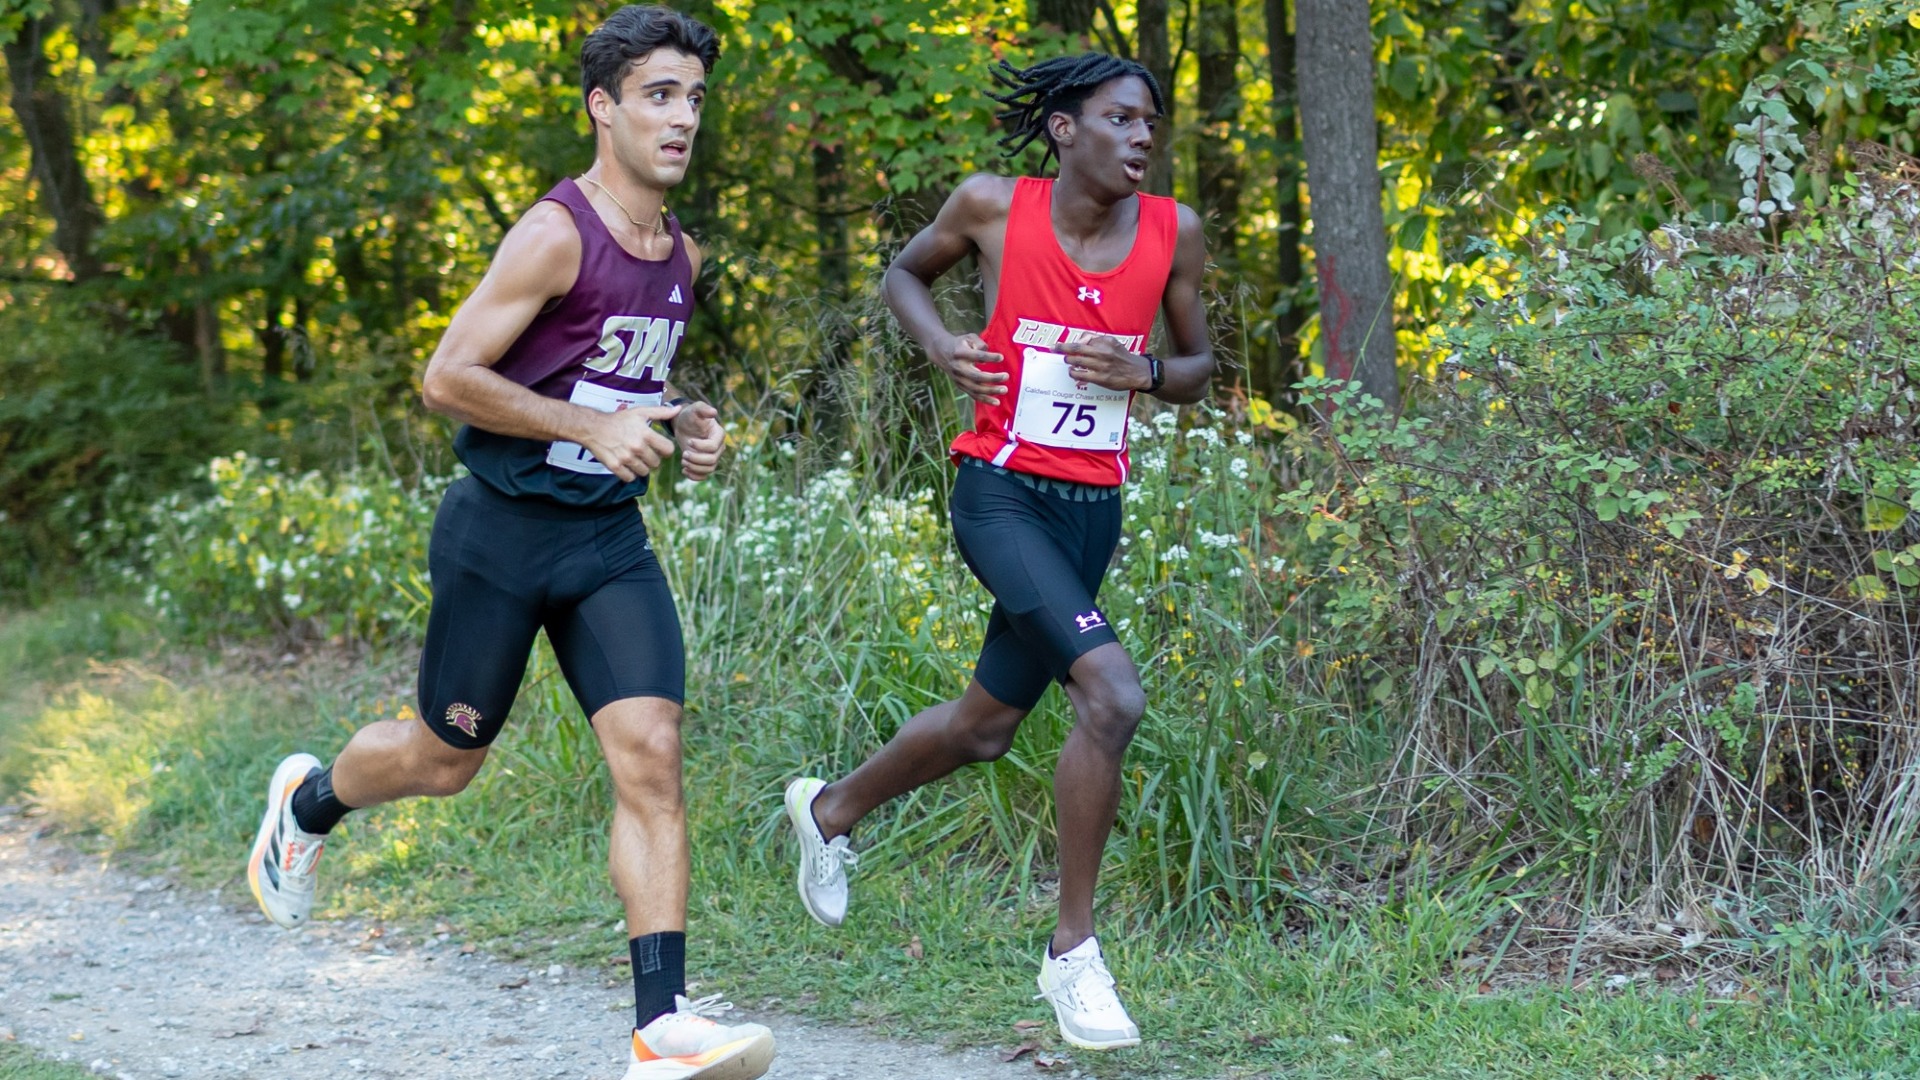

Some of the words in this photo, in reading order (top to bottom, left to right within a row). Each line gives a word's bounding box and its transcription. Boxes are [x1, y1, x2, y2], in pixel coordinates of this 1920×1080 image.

[1024, 386, 1051, 396] Caldwell
[1052, 390, 1074, 399] Cougar
[1075, 393, 1094, 401] Chase
[1051, 401, 1097, 437] 75
